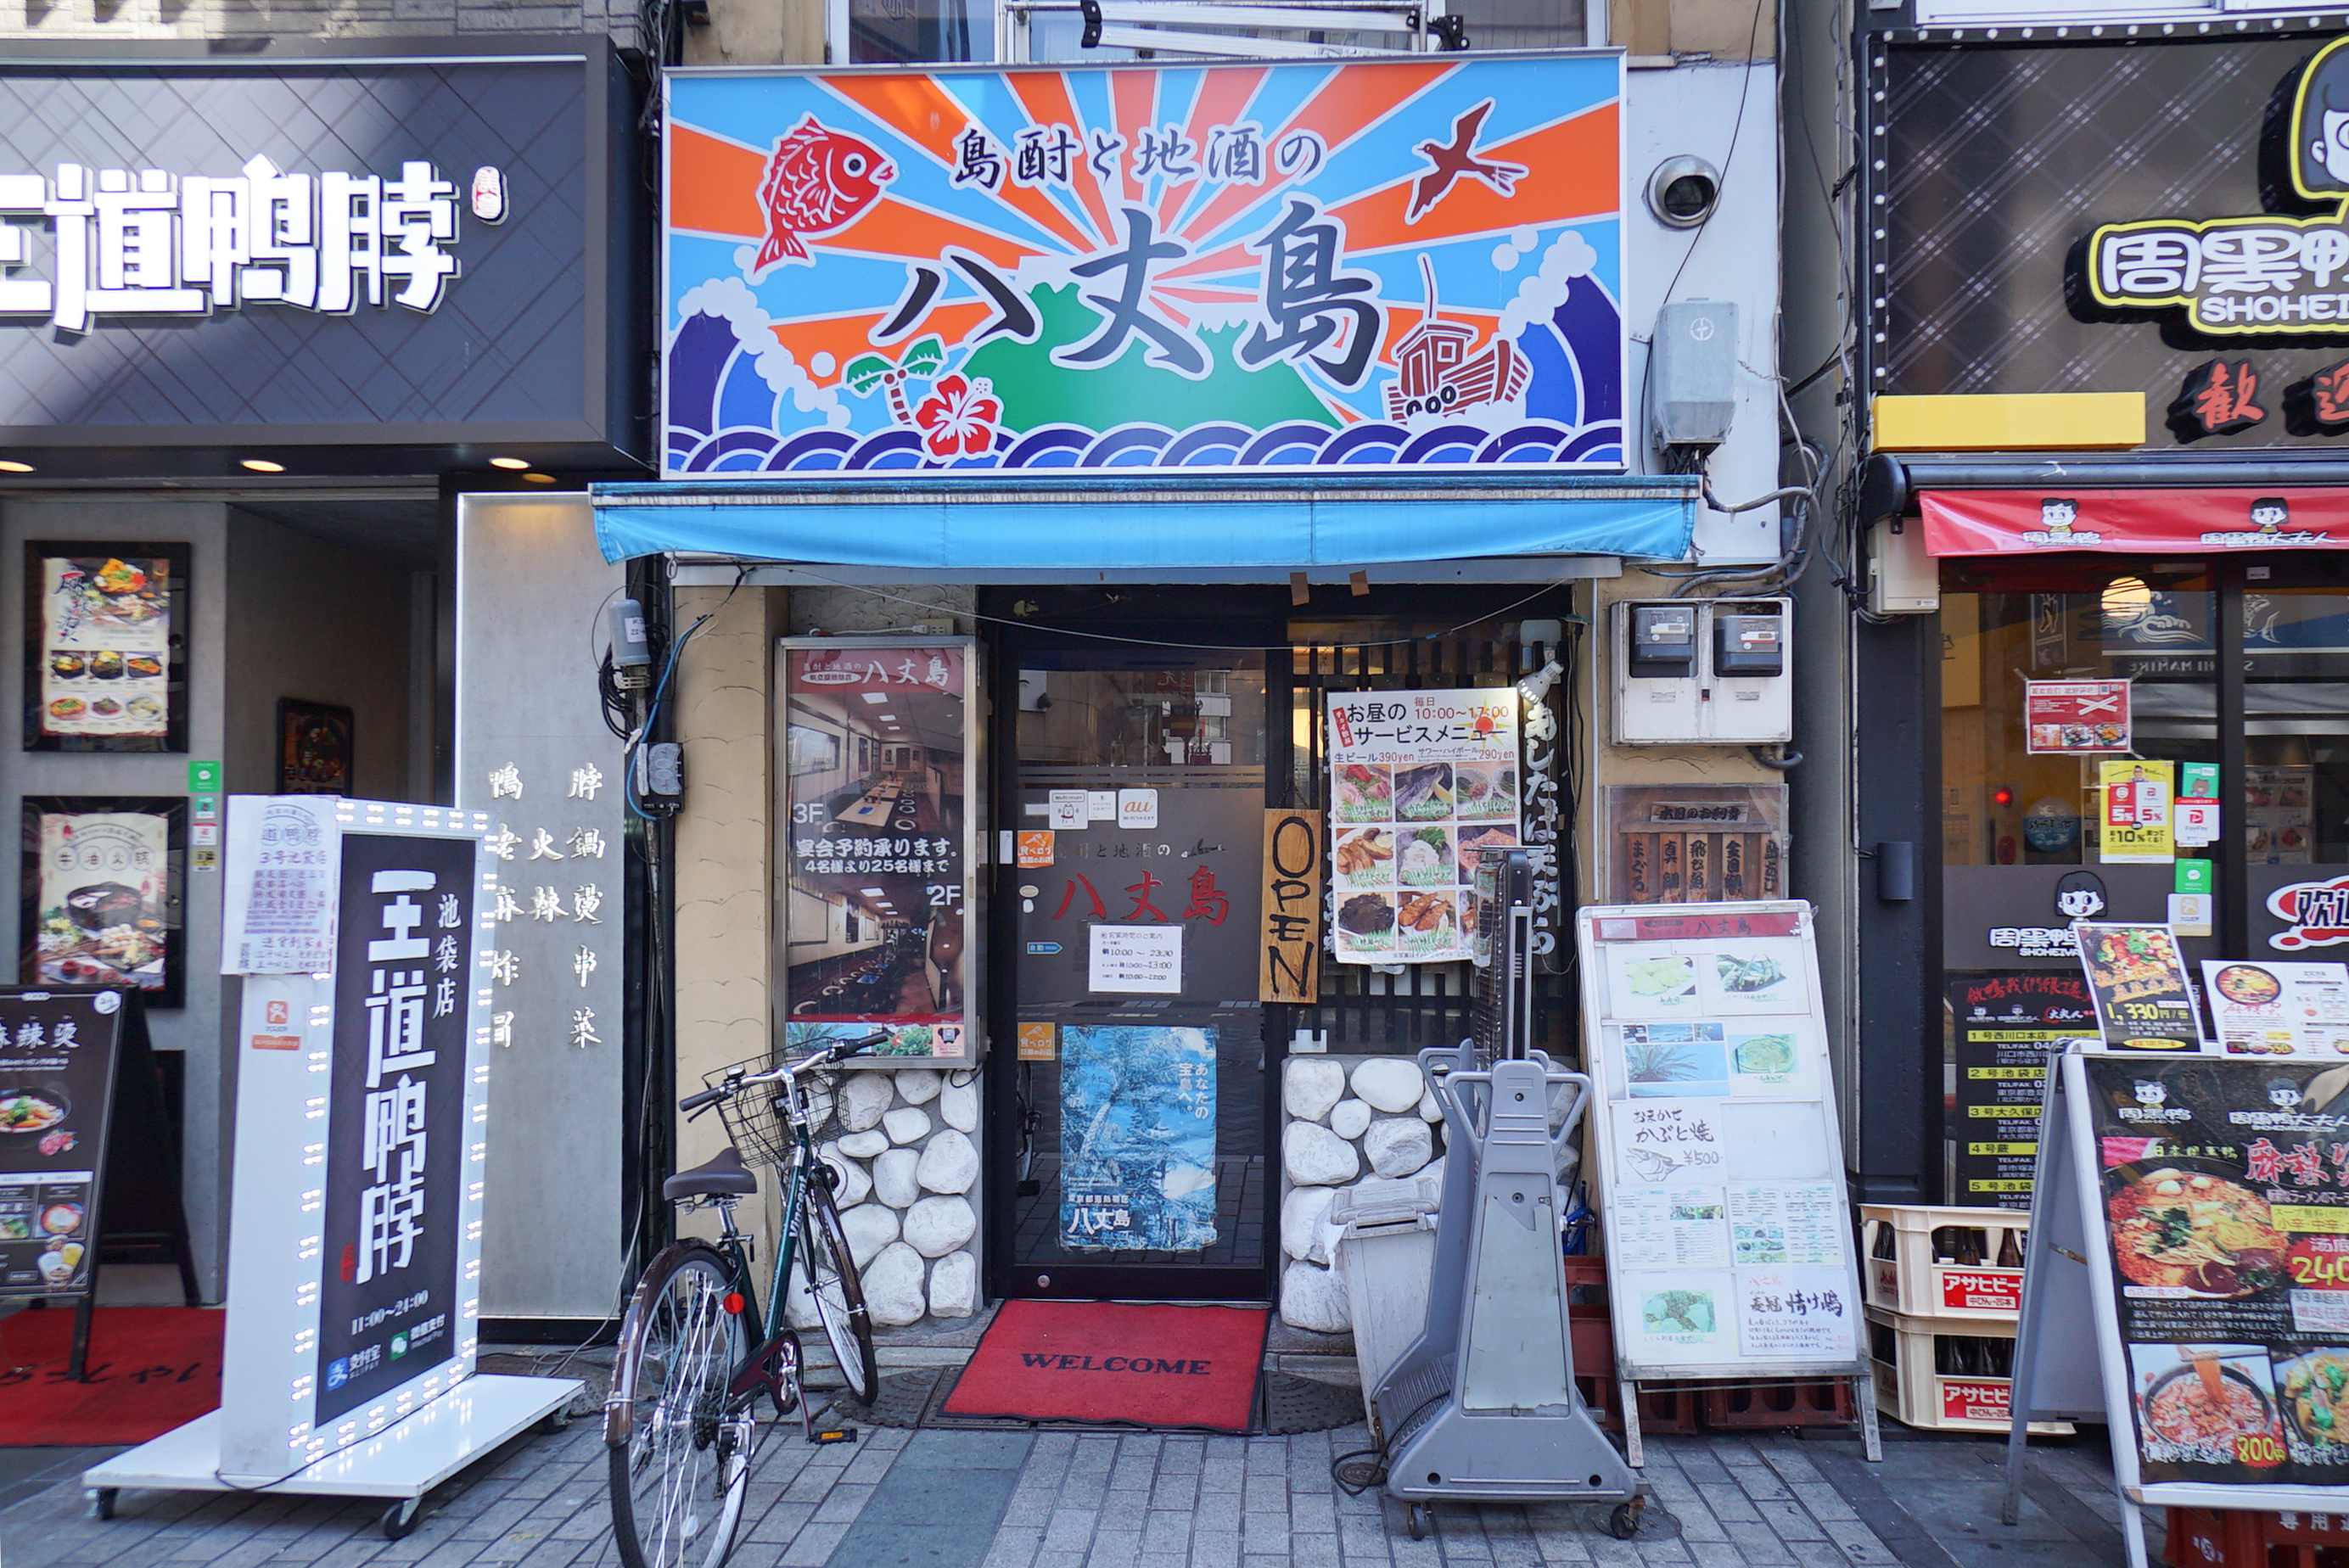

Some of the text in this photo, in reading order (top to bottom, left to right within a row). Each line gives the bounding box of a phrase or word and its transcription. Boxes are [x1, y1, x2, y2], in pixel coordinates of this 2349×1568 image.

[956, 128, 1320, 188] 島酎と地酒の
[877, 201, 1379, 384] 八丈島
[861, 656, 949, 686] 八丈島
[1347, 703, 1406, 722] お昼の
[1415, 697, 1435, 707] 毎日
[1354, 725, 1507, 745] サービスメニュー
[1479, 749, 1515, 760] 290yen
[793, 804, 824, 824] 3F
[1124, 801, 1154, 813] au
[796, 837, 957, 858] 宴会予約承ります。
[805, 859, 949, 874] 4名様より25名様まで
[1632, 840, 1647, 892] まぐろ
[930, 885, 961, 906] 2F
[1053, 865, 1229, 927] 八丈島
[1268, 816, 1315, 997] OPEN
[433, 893, 462, 1018] 池袋店
[1020, 1037, 1052, 1047] 食べログ
[1179, 1062, 1193, 1112] 宝島へ。
[1195, 1062, 1208, 1119] あなたの
[1633, 1108, 1684, 1124] おまかせ
[1635, 1120, 1714, 1144] かぶと焼
[789, 1174, 807, 1238] Vincent
[1068, 1207, 1130, 1235] 八丈島
[1944, 1274, 2023, 1294] アサヒビー
[1021, 1352, 1212, 1375] WELCOME
